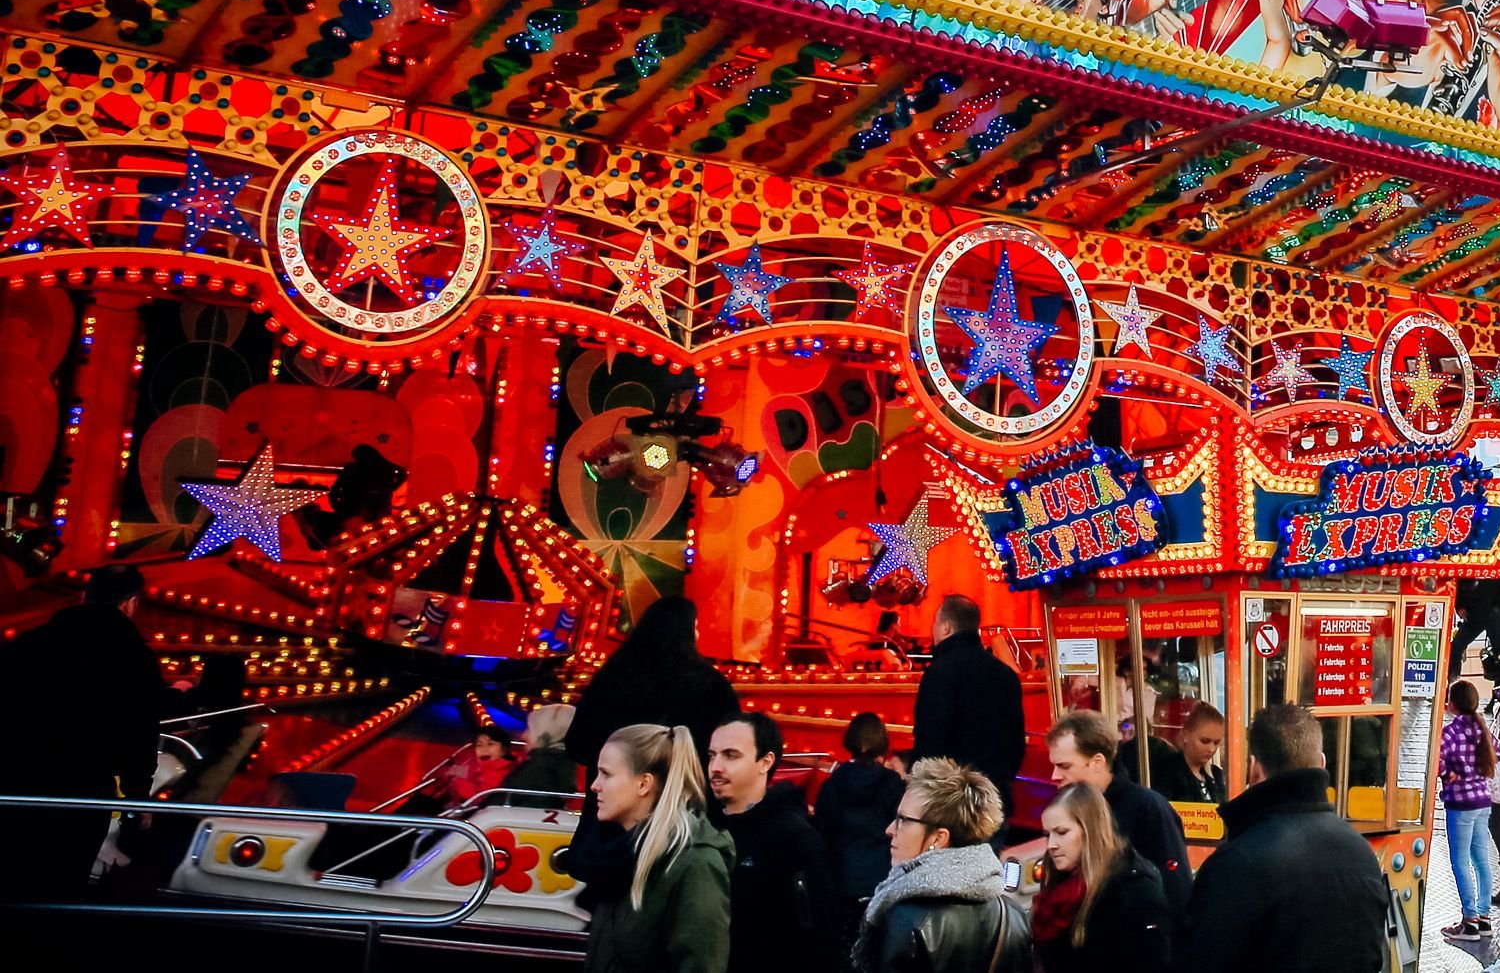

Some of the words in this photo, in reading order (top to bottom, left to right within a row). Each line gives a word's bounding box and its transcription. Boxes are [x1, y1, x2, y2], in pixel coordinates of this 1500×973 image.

[1015, 463, 1127, 530] MUSIK
[1324, 465, 1462, 515] MUSIK
[1006, 498, 1159, 580] EXPRESS
[1284, 504, 1475, 566] EXPRESS
[1102, 611, 1120, 619] Jahre
[1142, 609, 1158, 618] Nicht
[1172, 608, 1184, 617] und
[1185, 608, 1220, 618] aussteigen
[1144, 622, 1162, 631] bevor
[1162, 621, 1174, 630] das
[1175, 619, 1205, 629] Karussell
[1205, 619, 1218, 628] hält
[1320, 619, 1371, 633] FAHRPREIS
[1407, 663, 1433, 671] POLIZEI
[1414, 673, 1426, 681] 110
[542, 810, 559, 825] 2
[1183, 822, 1209, 833] Haftung
